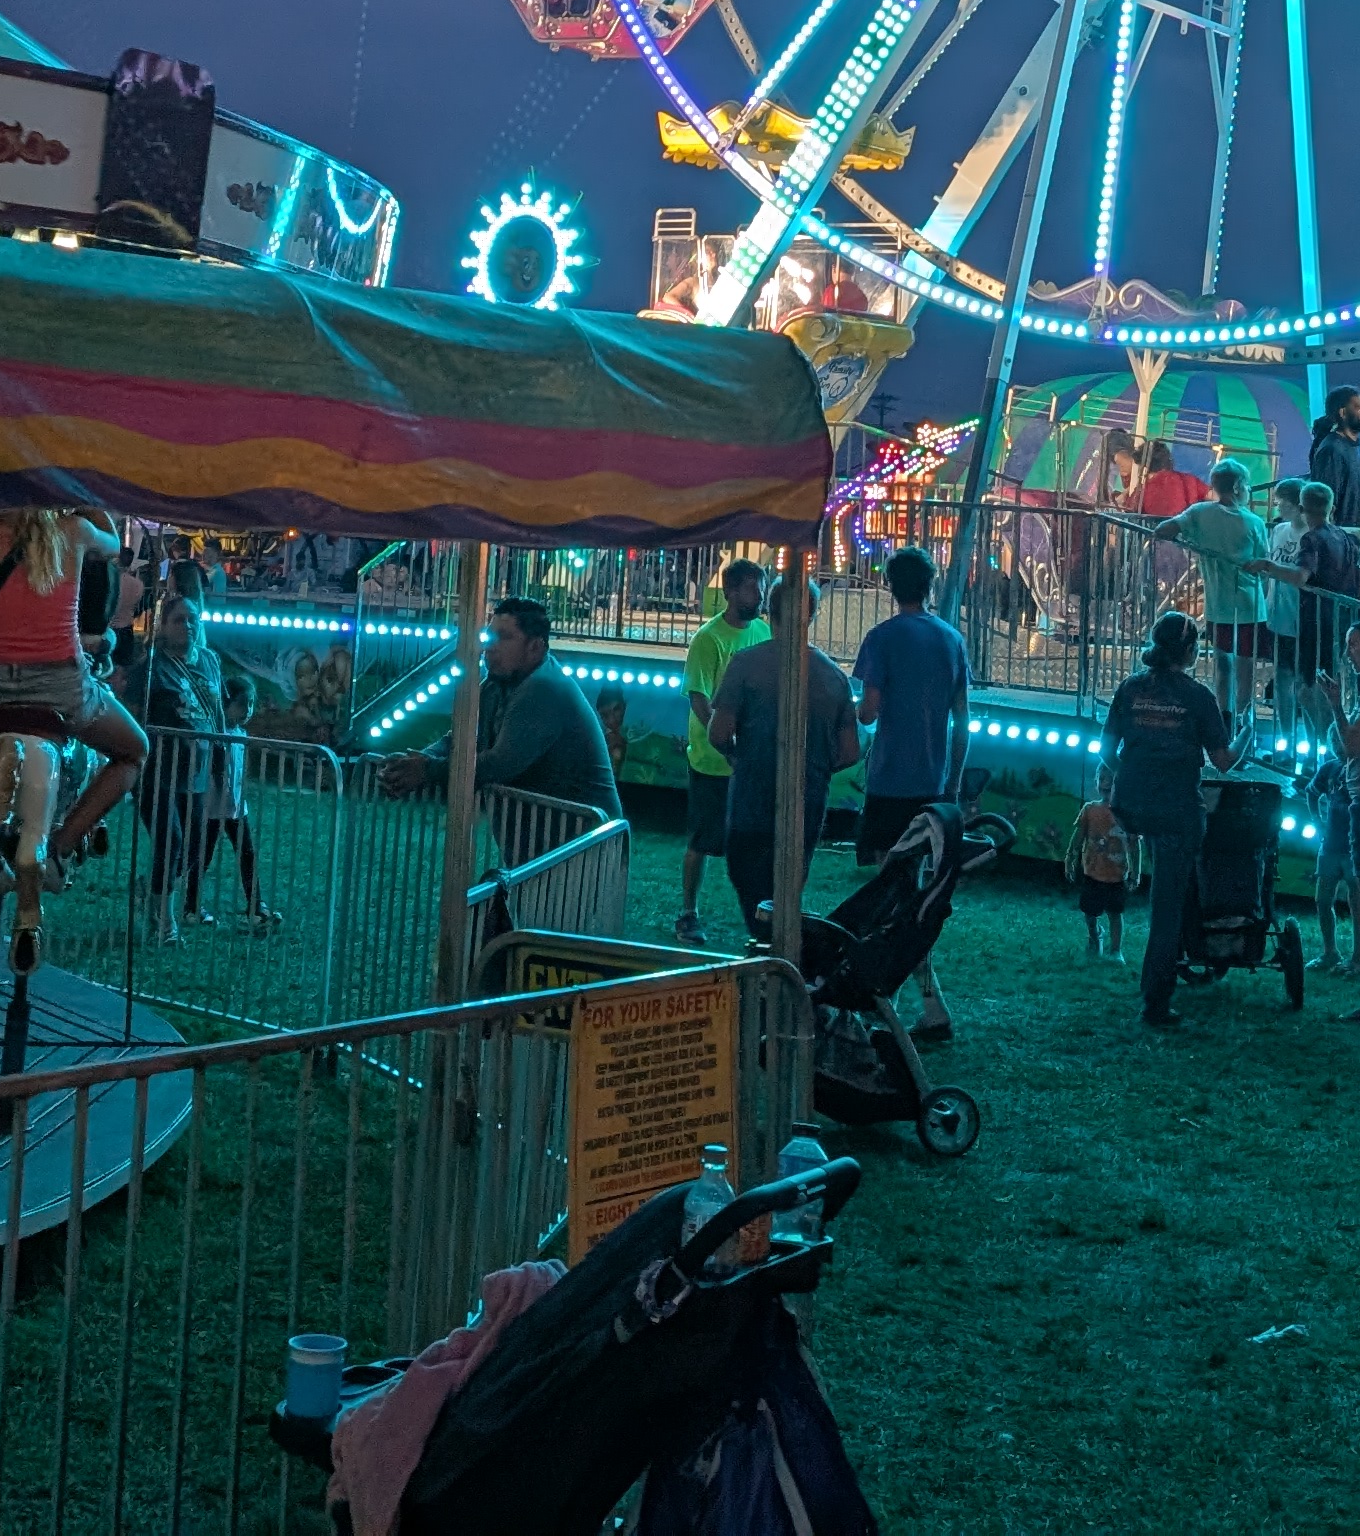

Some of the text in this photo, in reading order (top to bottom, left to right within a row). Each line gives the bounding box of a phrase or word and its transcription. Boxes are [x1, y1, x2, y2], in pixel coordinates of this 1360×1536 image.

[583, 989, 727, 1029] FOR YOUR SAFETY:
